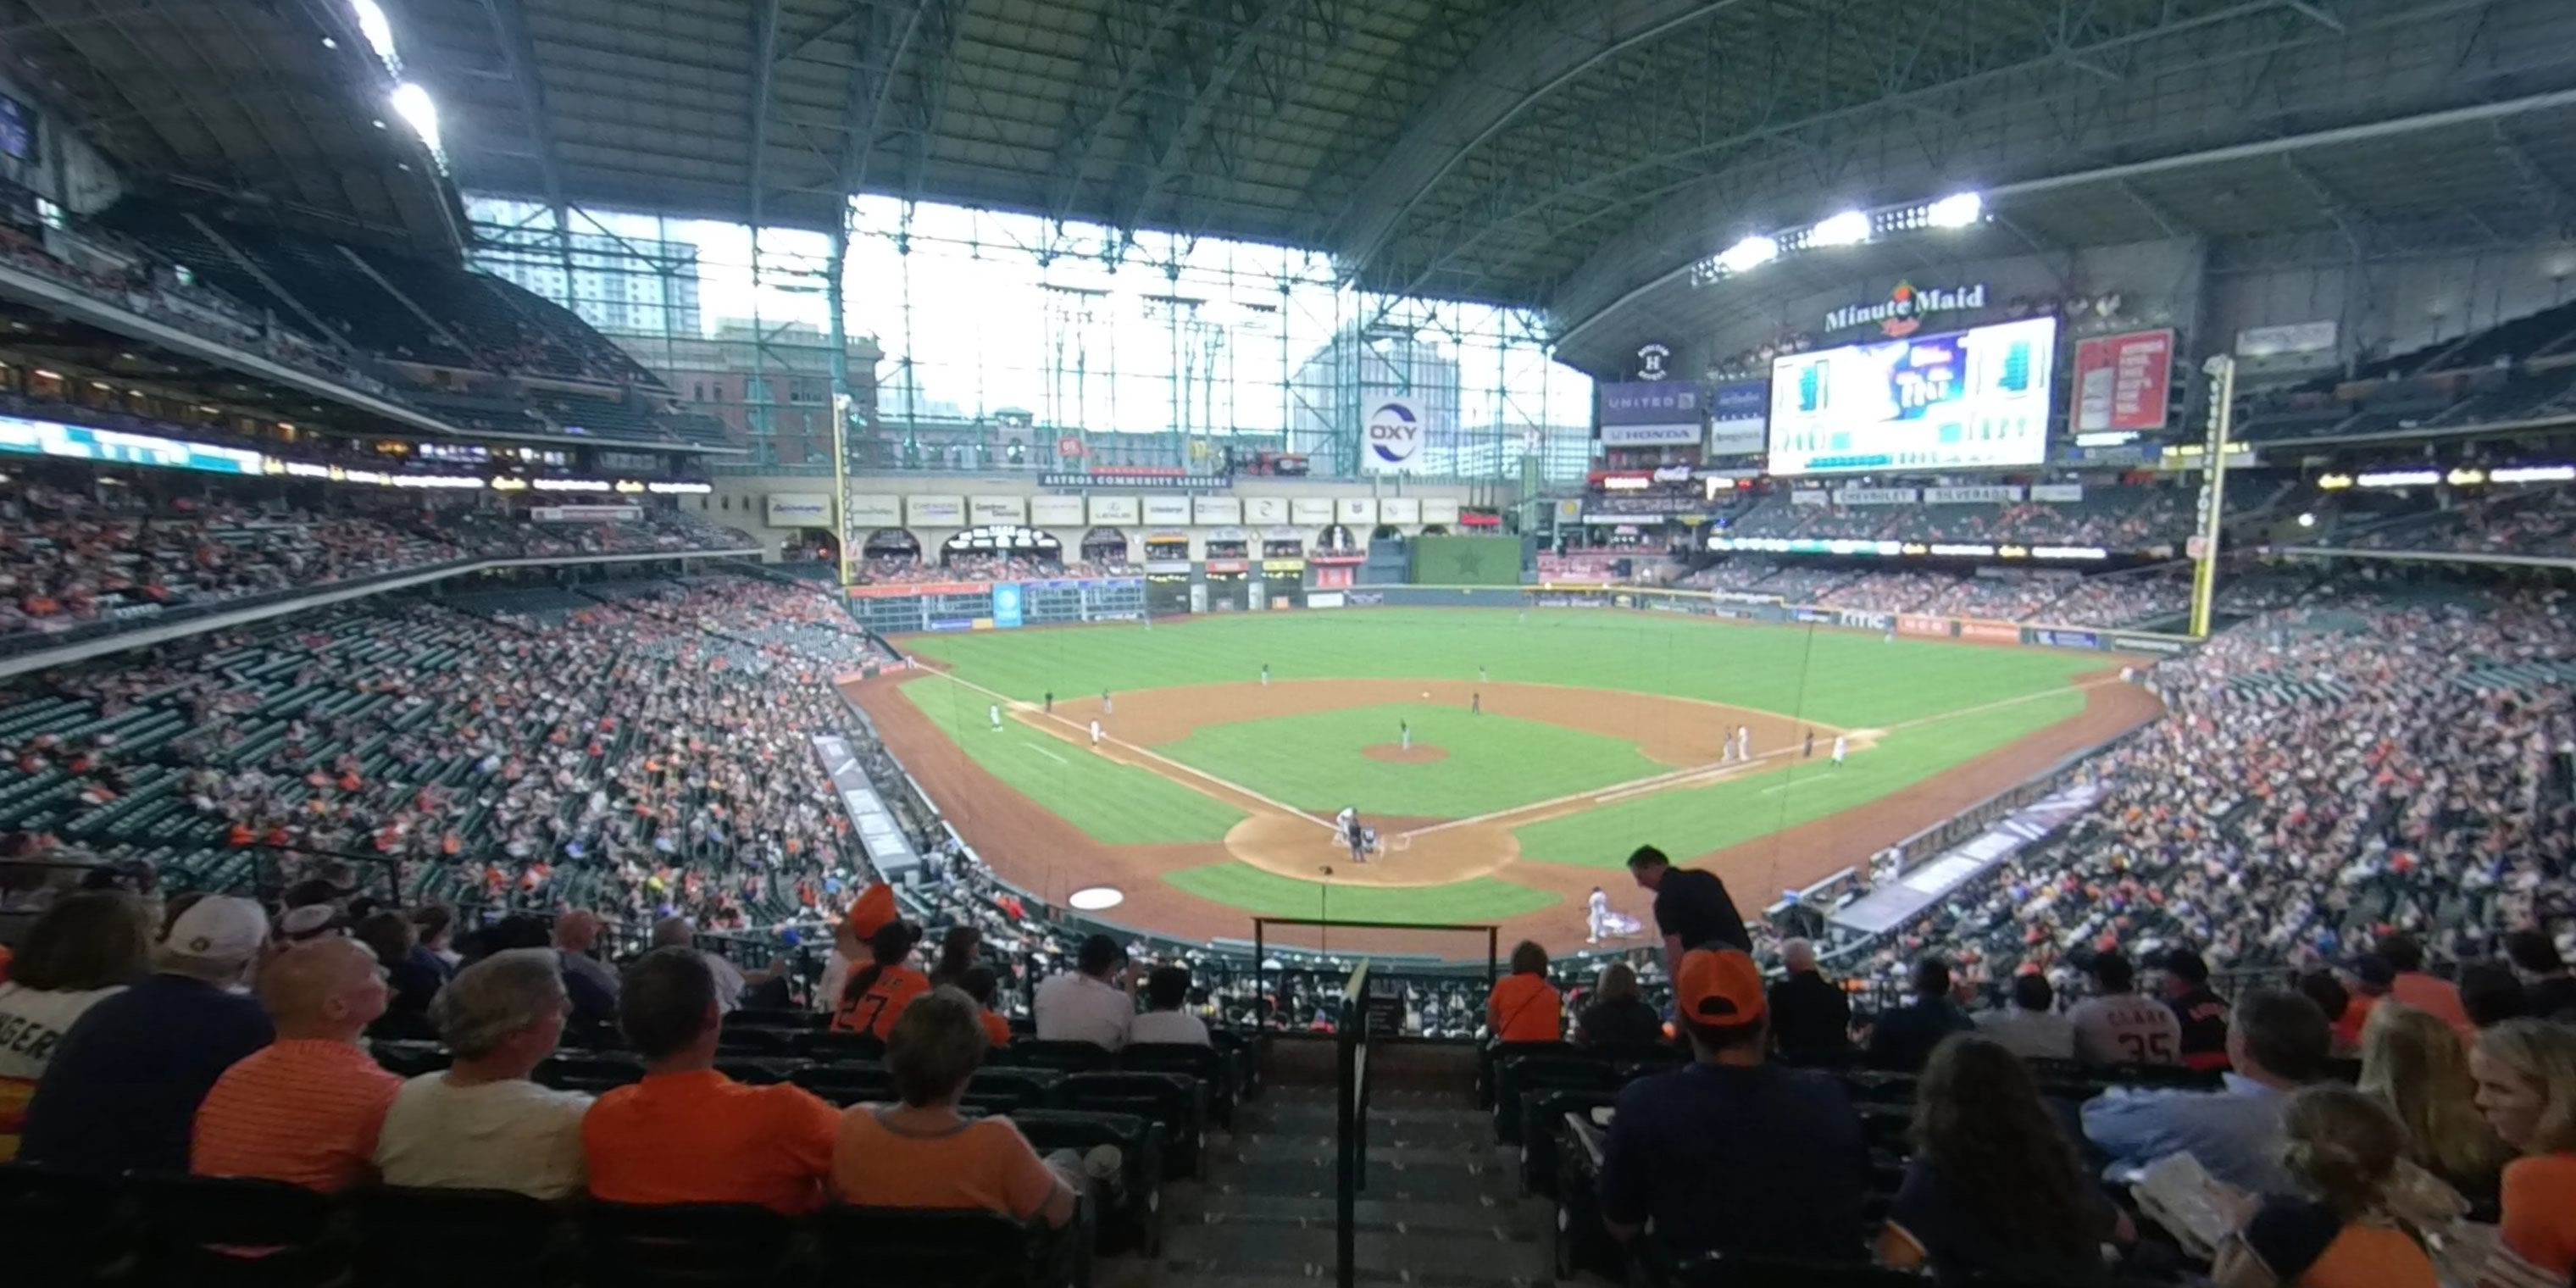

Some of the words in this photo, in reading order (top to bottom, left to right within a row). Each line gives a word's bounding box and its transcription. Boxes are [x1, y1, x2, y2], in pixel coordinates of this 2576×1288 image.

[1824, 299, 1912, 332] Minute
[1915, 284, 1985, 312] Maid
[1646, 356, 1661, 370] H
[1608, 396, 1674, 408] UNITED
[1370, 425, 1417, 440] OXY
[1625, 430, 1690, 440] HONDA
[1044, 475, 1094, 485] ASTROS
[1096, 476, 1173, 486] COMMUNITY
[1176, 476, 1227, 486] LEADERS
[1839, 490, 1908, 502] CHEVROLET
[1935, 489, 2010, 502] SILVERADO
[2107, 1009, 2166, 1025] CLARK
[2118, 1032, 2172, 1063] 35
